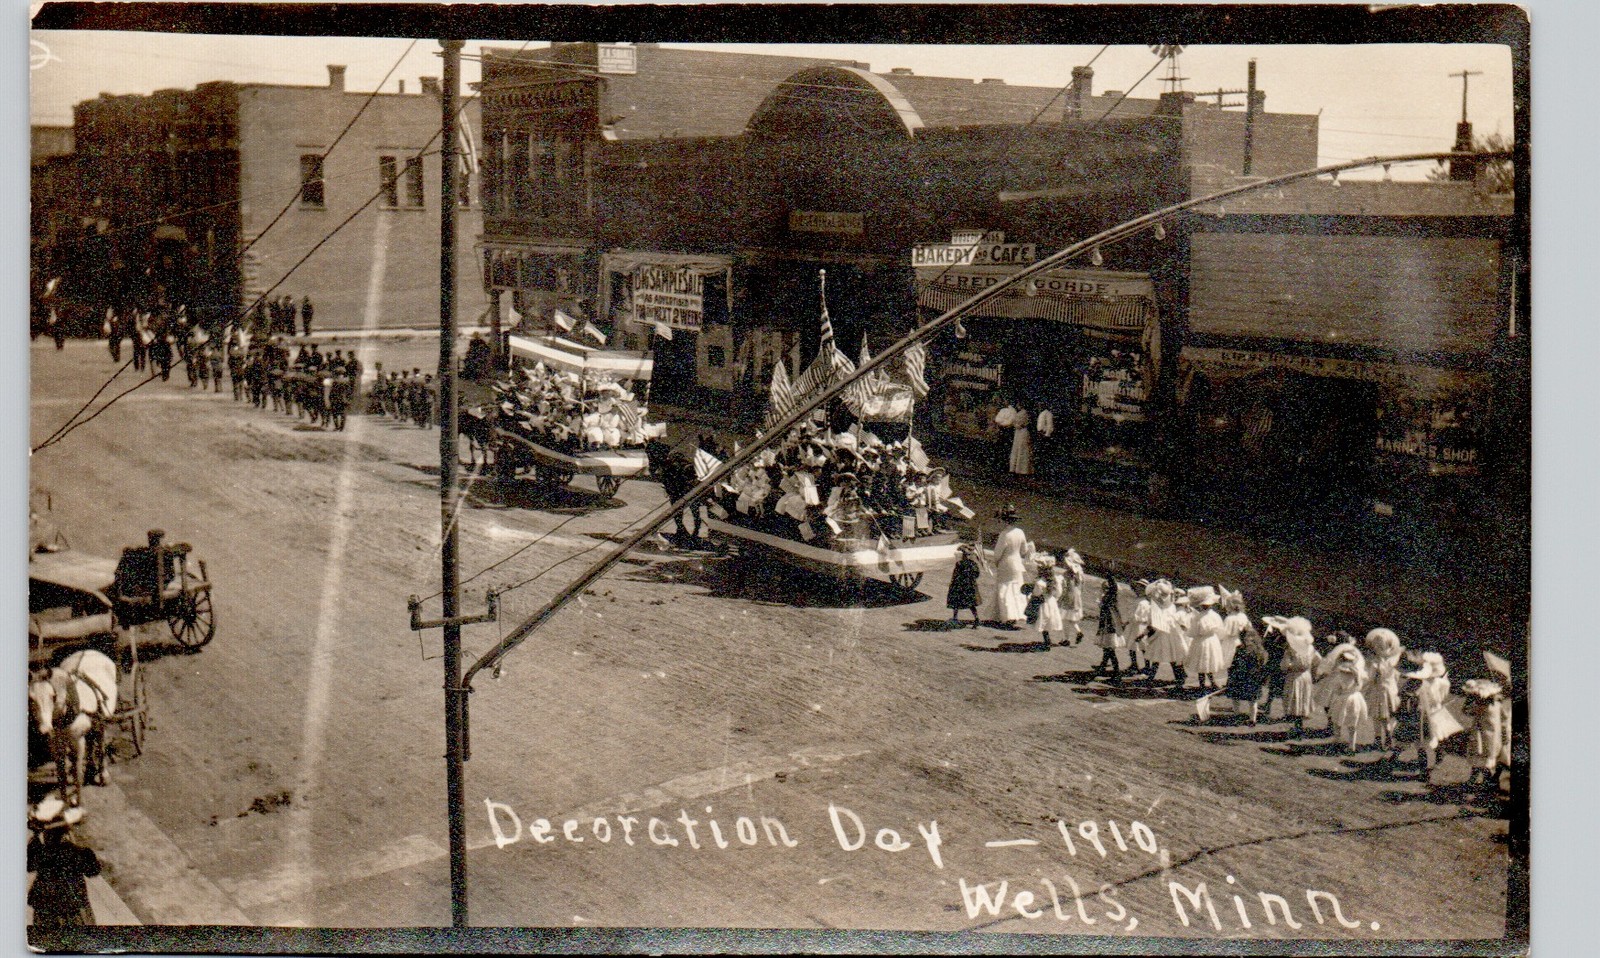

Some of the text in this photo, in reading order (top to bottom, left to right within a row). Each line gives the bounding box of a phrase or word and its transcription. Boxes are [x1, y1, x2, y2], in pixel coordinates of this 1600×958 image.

[915, 246, 972, 264] BAKERY
[943, 275, 998, 287] FRED
[673, 308, 680, 324] 2
